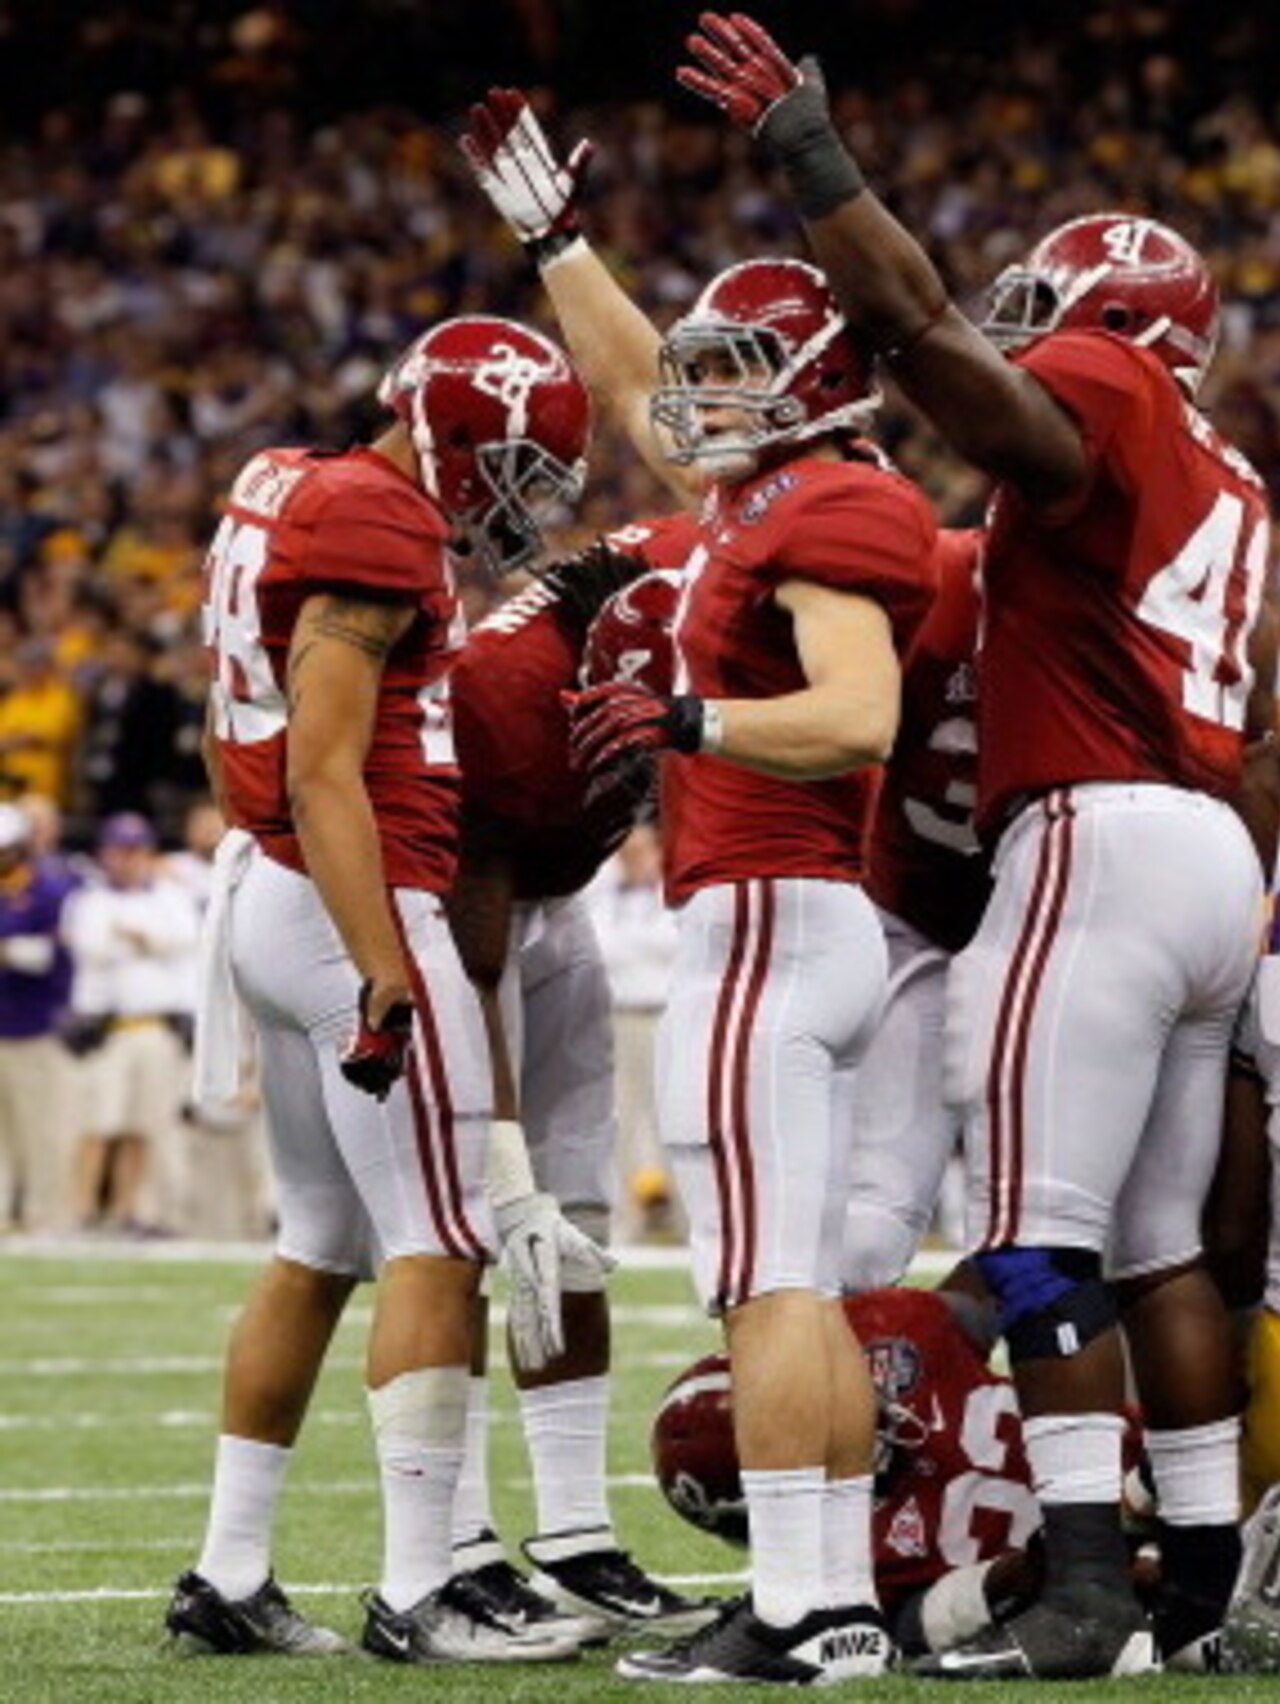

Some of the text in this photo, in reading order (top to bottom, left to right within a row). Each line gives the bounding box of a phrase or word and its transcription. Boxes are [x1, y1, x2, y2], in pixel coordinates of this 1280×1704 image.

[1102, 220, 1156, 266] 41
[470, 343, 538, 406] 28
[1134, 488, 1270, 732] 41
